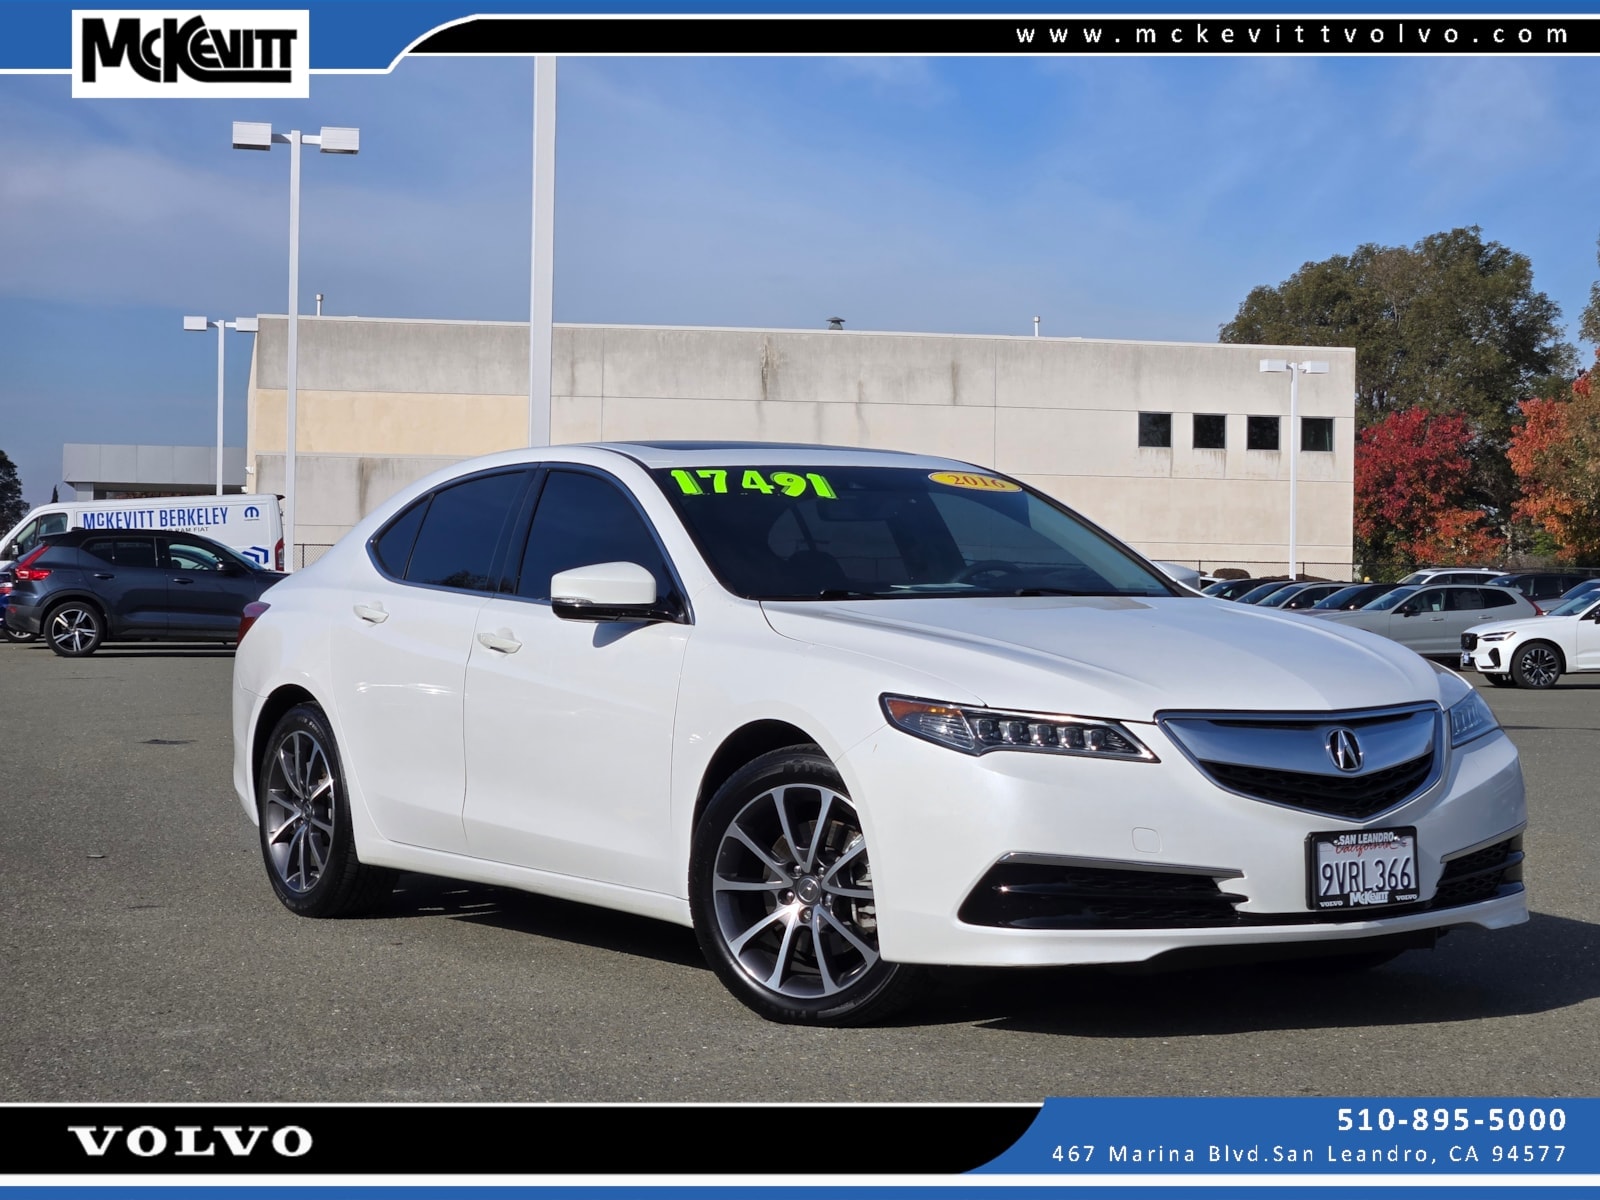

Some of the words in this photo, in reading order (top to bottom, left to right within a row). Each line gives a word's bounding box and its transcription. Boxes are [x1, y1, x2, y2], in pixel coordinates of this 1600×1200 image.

[947, 474, 1006, 489] 2016
[159, 507, 228, 527] BERKELEY
[1339, 834, 1357, 845] SAN
[1358, 832, 1394, 843] LEANDRO
[1321, 857, 1411, 896] 9VRL366
